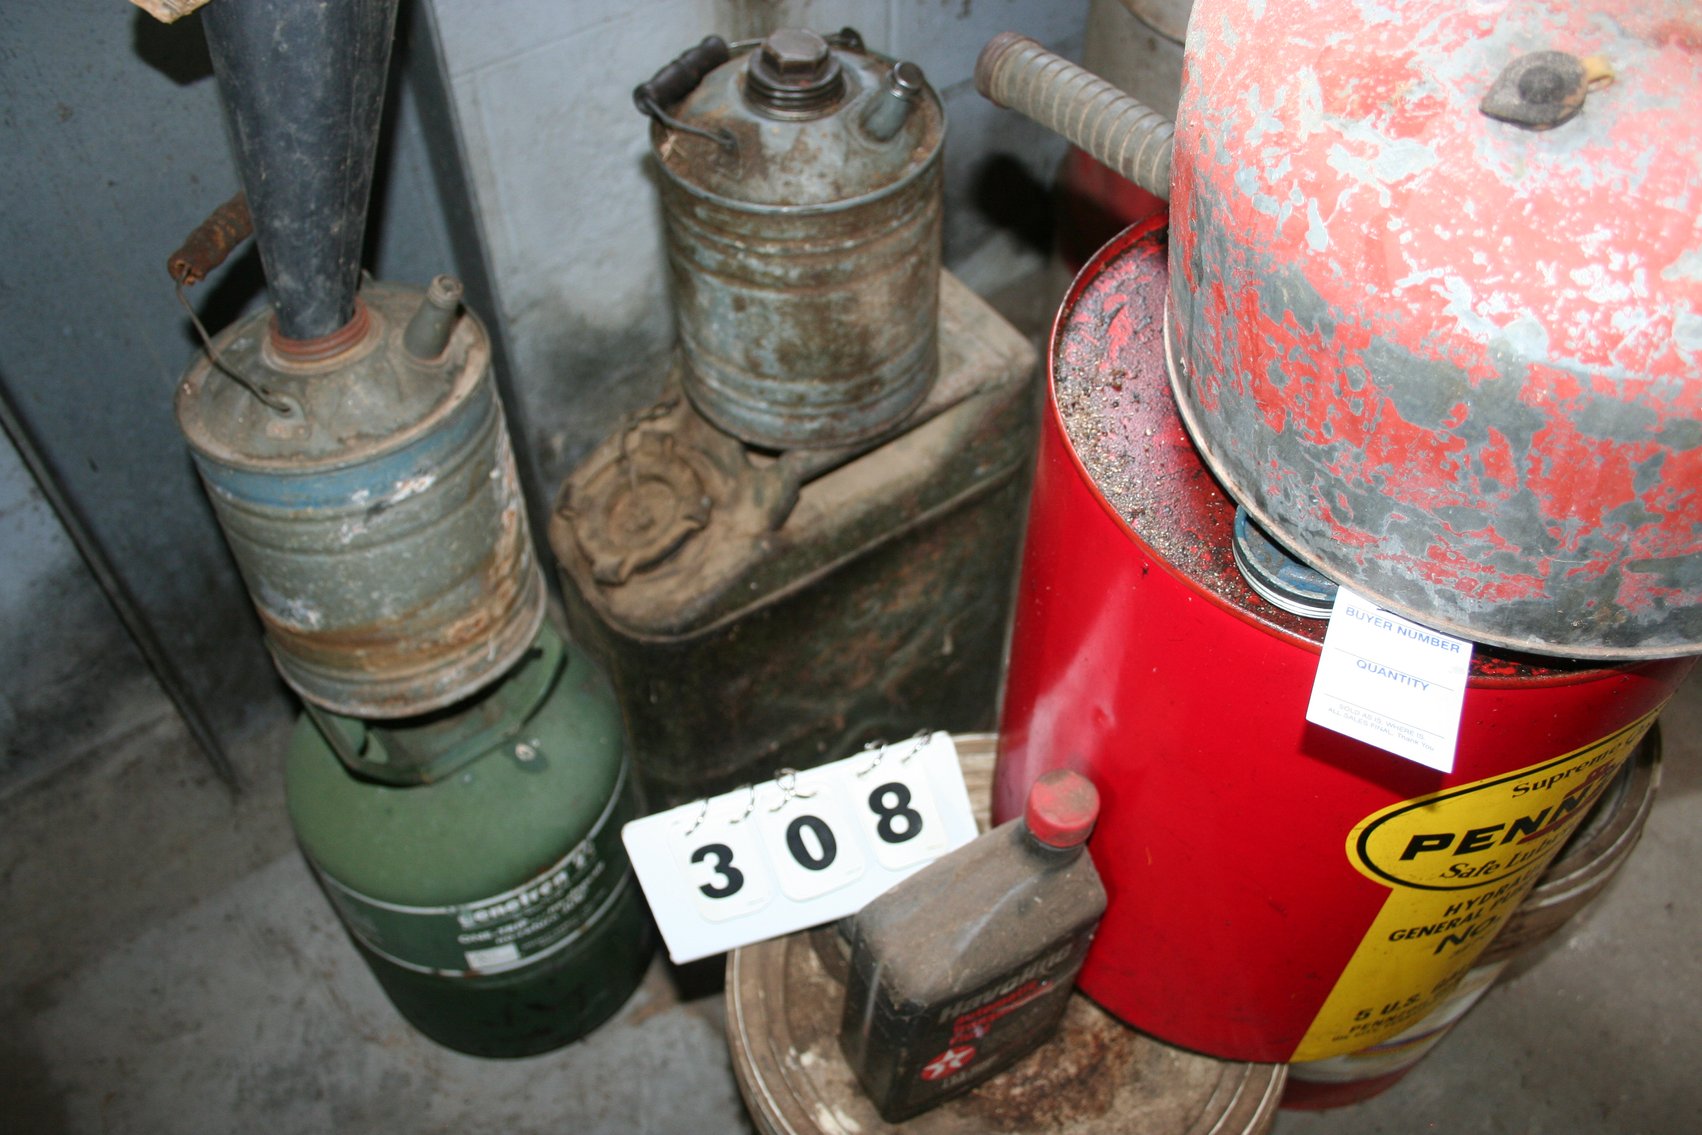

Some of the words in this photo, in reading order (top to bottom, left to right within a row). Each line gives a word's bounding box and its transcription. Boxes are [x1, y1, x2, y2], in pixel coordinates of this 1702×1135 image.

[1345, 606, 1393, 632] BUYER
[1397, 625, 1461, 655] NUMBER
[1356, 659, 1430, 692] QUANTITY
[1328, 707, 1342, 717] ALL
[1343, 712, 1369, 727] SALES
[1339, 703, 1360, 716] SOLD
[1362, 712, 1373, 721] AS
[1385, 720, 1415, 737] WHERE
[1511, 740, 1623, 798] Supreme
[690, 781, 924, 900] 308
[1440, 859, 1500, 880] Safe
[1388, 907, 1484, 942] GENERAL
